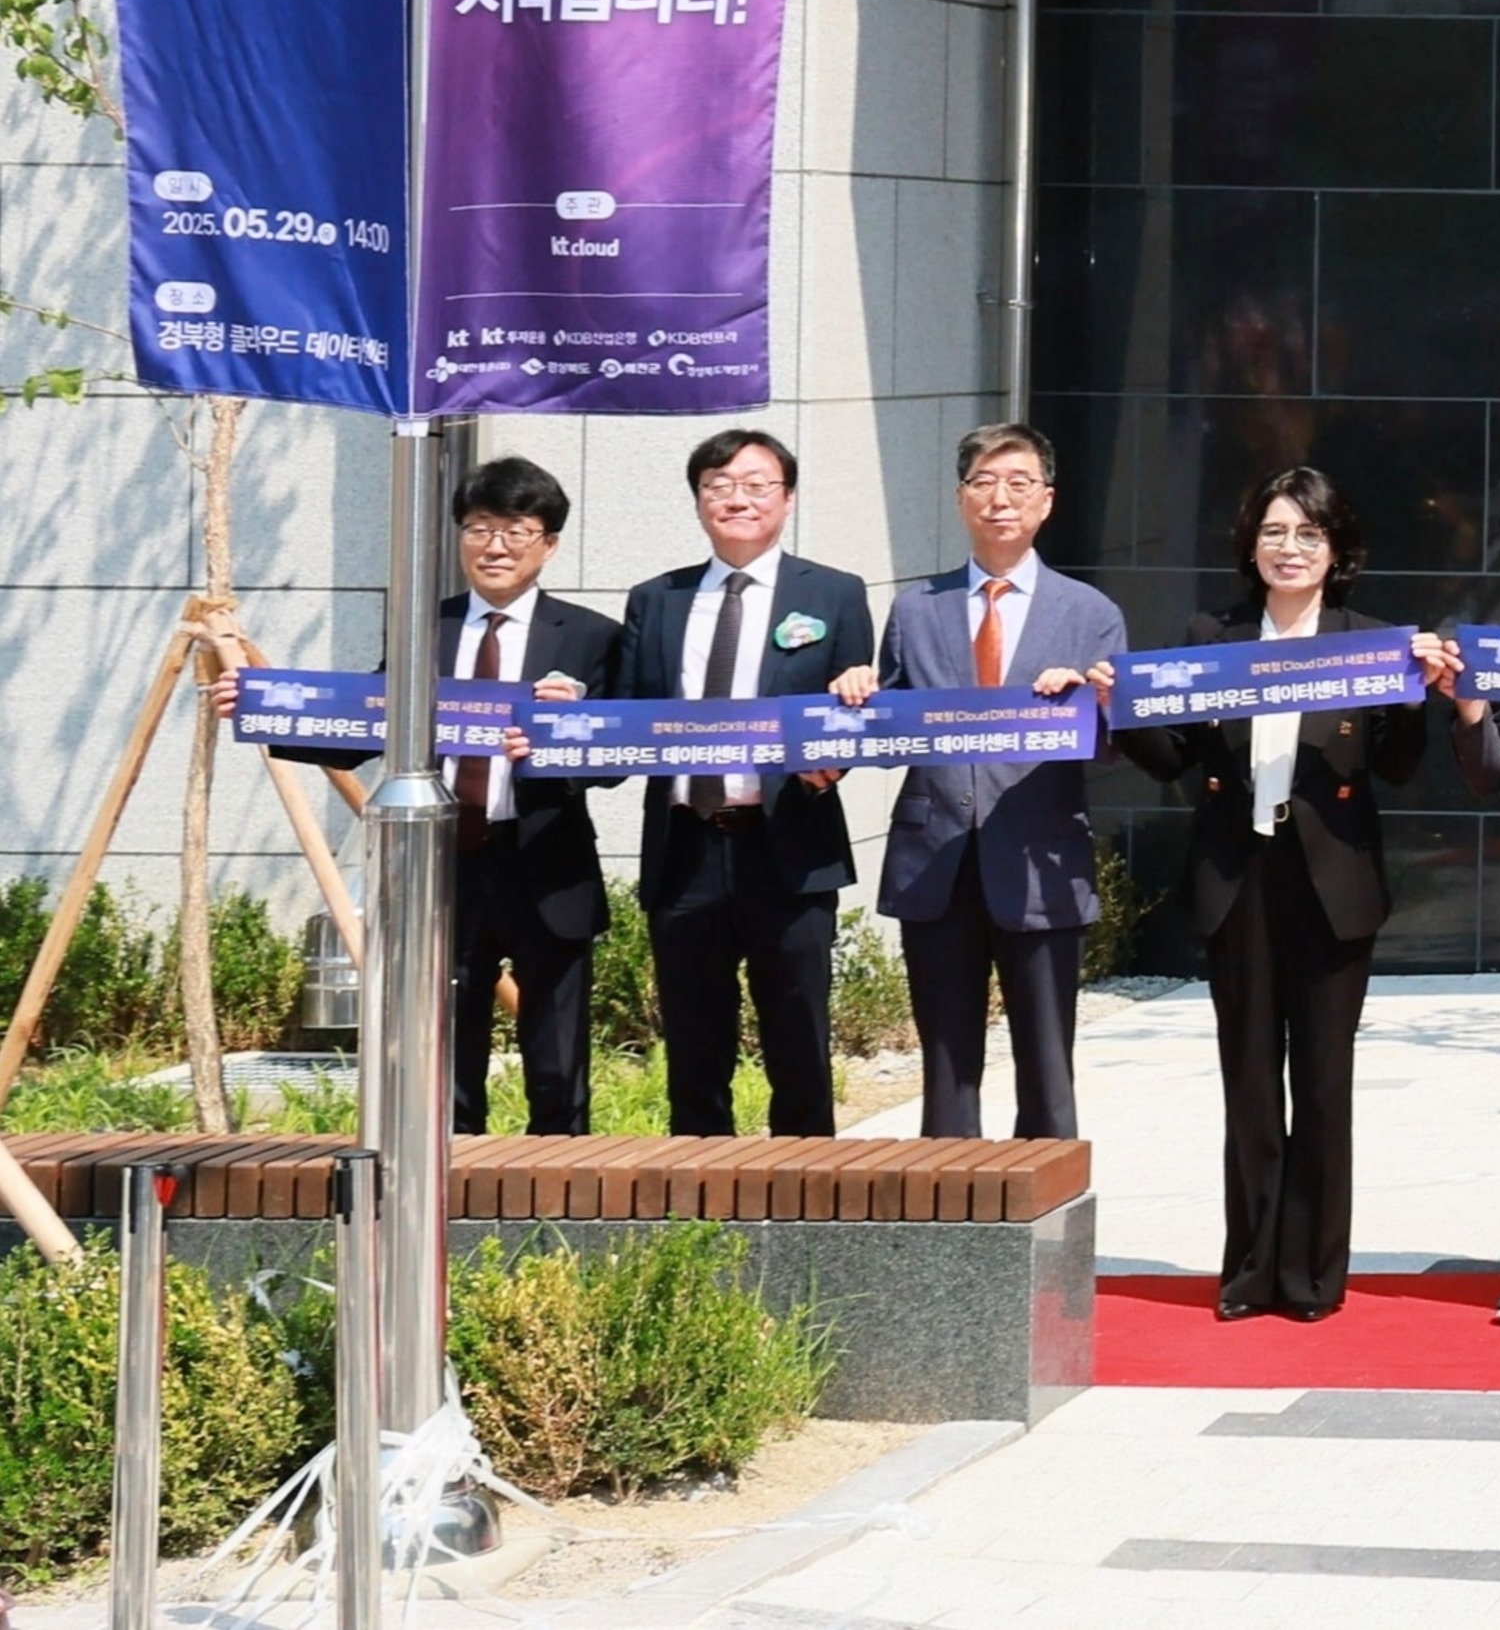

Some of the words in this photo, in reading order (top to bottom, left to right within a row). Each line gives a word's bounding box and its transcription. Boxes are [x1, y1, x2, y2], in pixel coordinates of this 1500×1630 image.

[163, 211, 221, 235] 2025.
[345, 219, 389, 253] 14:00
[552, 237, 570, 255] kt
[571, 238, 619, 256] cloud
[157, 321, 224, 351] 경북형
[230, 325, 300, 354] 클라우드
[305, 332, 389, 371] 데이터센터
[1133, 694, 1184, 717] 경북형
[1188, 688, 1259, 711] 클라우드
[1262, 678, 1348, 703] 데이터센터
[1351, 673, 1404, 696] 준공식
[802, 738, 856, 760] 경북형
[860, 736, 929, 756] 클라우드
[934, 732, 1019, 753] 데이터센터
[1023, 729, 1078, 750] 준공식
